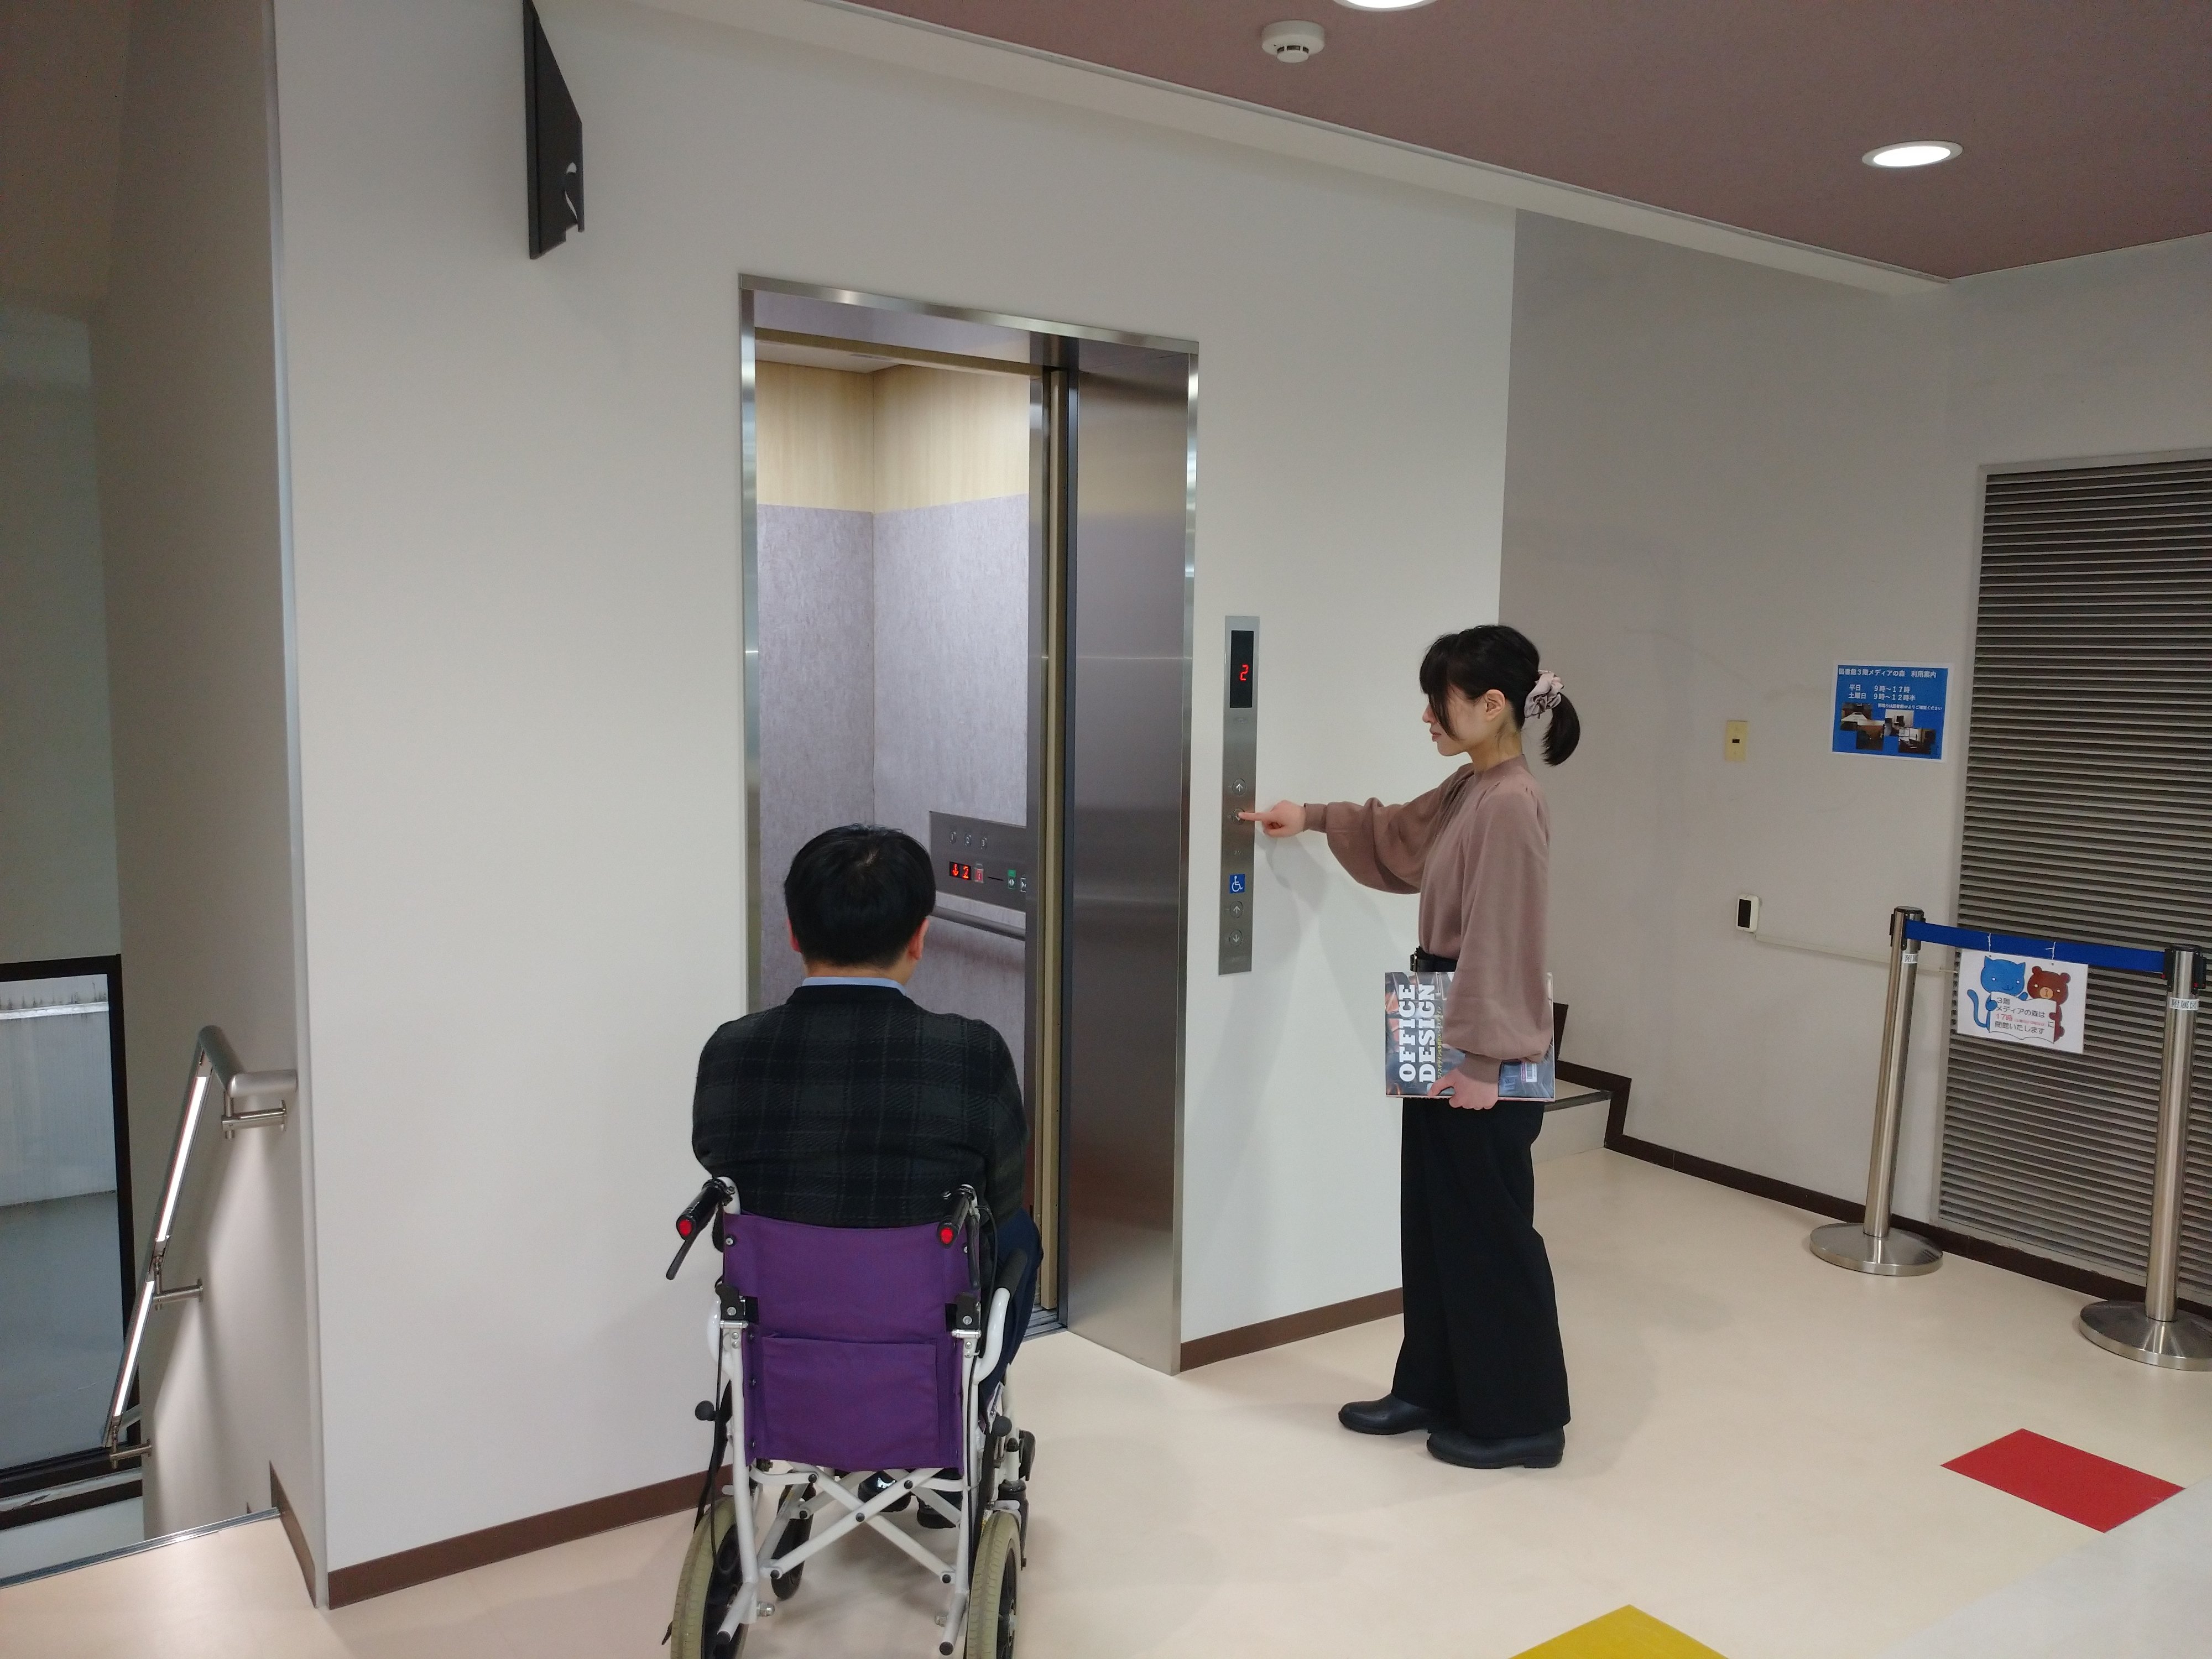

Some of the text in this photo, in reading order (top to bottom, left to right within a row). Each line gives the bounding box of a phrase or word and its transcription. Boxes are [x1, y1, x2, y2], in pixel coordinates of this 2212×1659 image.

[1239, 664, 1249, 681] 2
[1911, 670, 1937, 679] 利用案内
[962, 865, 969, 880] 2
[1997, 997, 2011, 1005] 3階
[1995, 1013, 2013, 1021] 17時
[1996, 1005, 2046, 1018] メディアの森は
[1399, 984, 1416, 1082] OFFICE
[1418, 984, 1436, 1082] DESIGN
